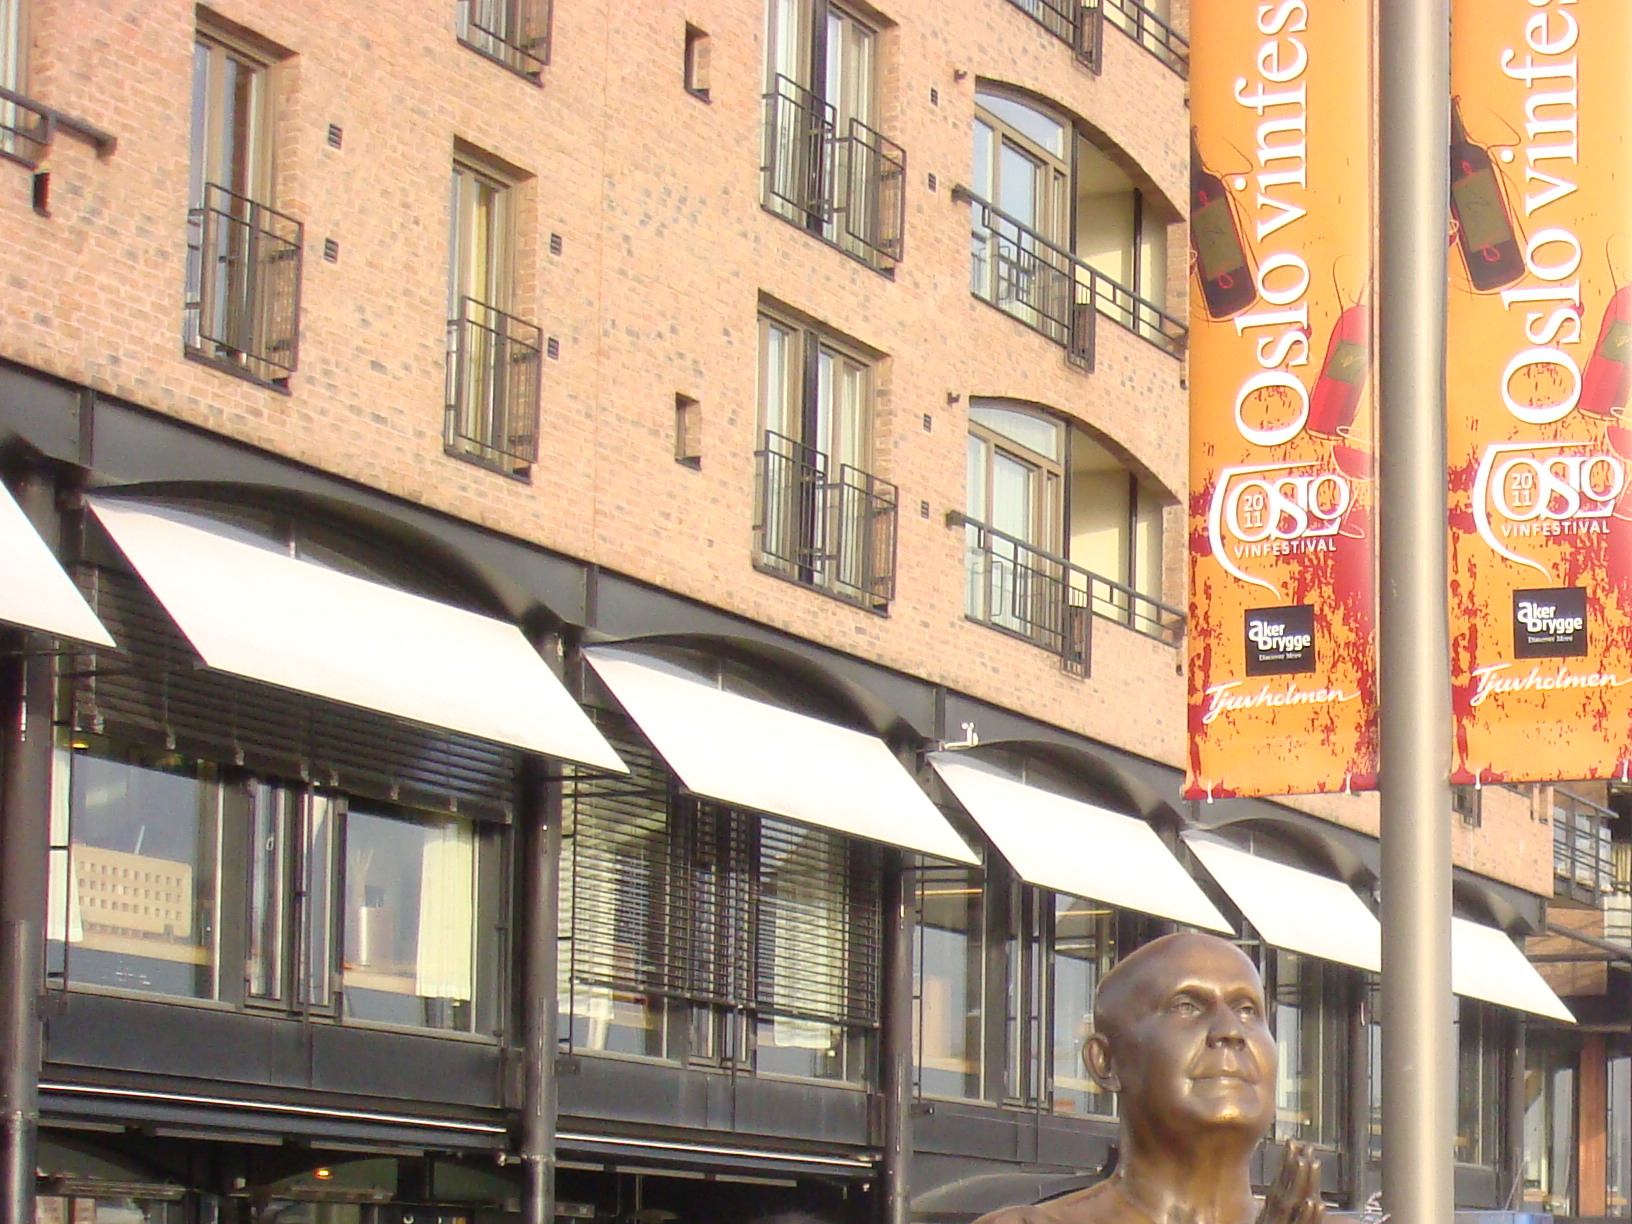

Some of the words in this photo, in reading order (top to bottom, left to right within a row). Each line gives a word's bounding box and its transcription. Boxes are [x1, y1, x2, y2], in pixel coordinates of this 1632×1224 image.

[1500, 0, 1580, 216] vinfe
[1500, 228, 1582, 424] Oslo
[1234, 252, 1311, 447] Oslo
[1511, 473, 1533, 490] 20
[1243, 494, 1264, 512] 20
[1511, 489, 1533, 507] 11
[1243, 511, 1264, 528] 11
[1501, 520, 1611, 538] VINFESTIVAL
[1233, 538, 1337, 559] VINFESTIVAL
[1517, 602, 1556, 623] aker
[1248, 620, 1285, 641] aker
[1202, 681, 1362, 724] Tjuvholmen
